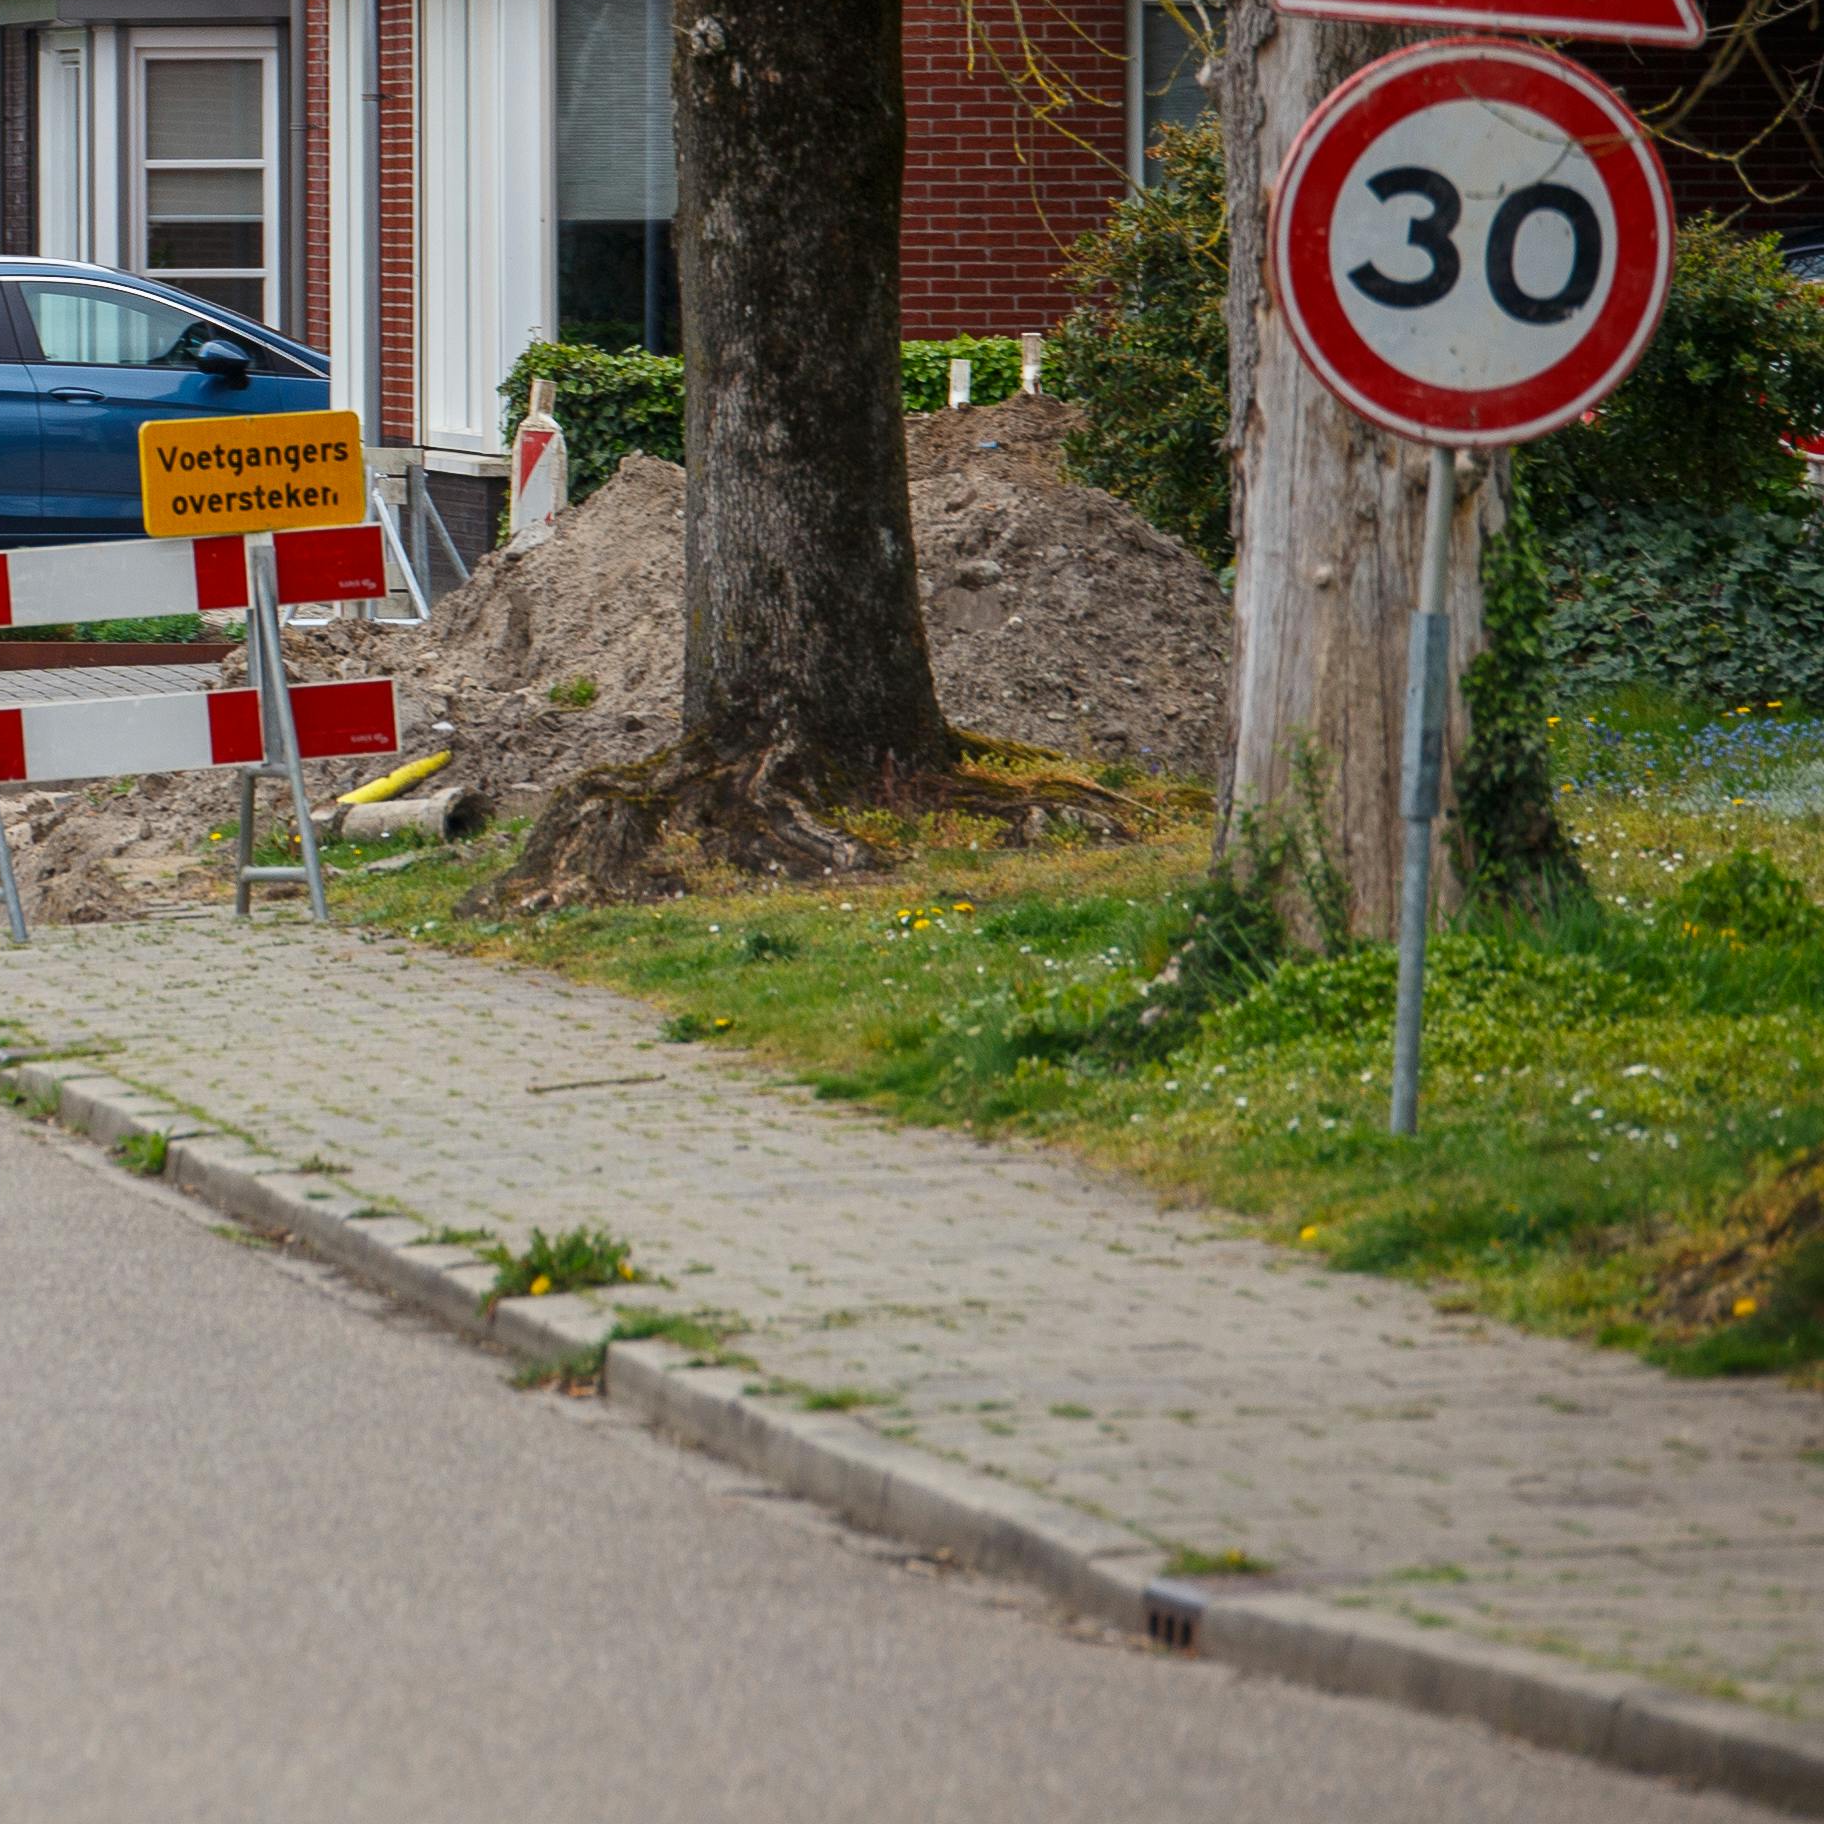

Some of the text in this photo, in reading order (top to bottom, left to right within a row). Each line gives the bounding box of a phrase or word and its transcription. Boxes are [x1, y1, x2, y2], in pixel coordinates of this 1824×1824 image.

[1347, 165, 1603, 325] 30
[156, 442, 349, 476] Voetgangers
[171, 482, 339, 515] oversteken
